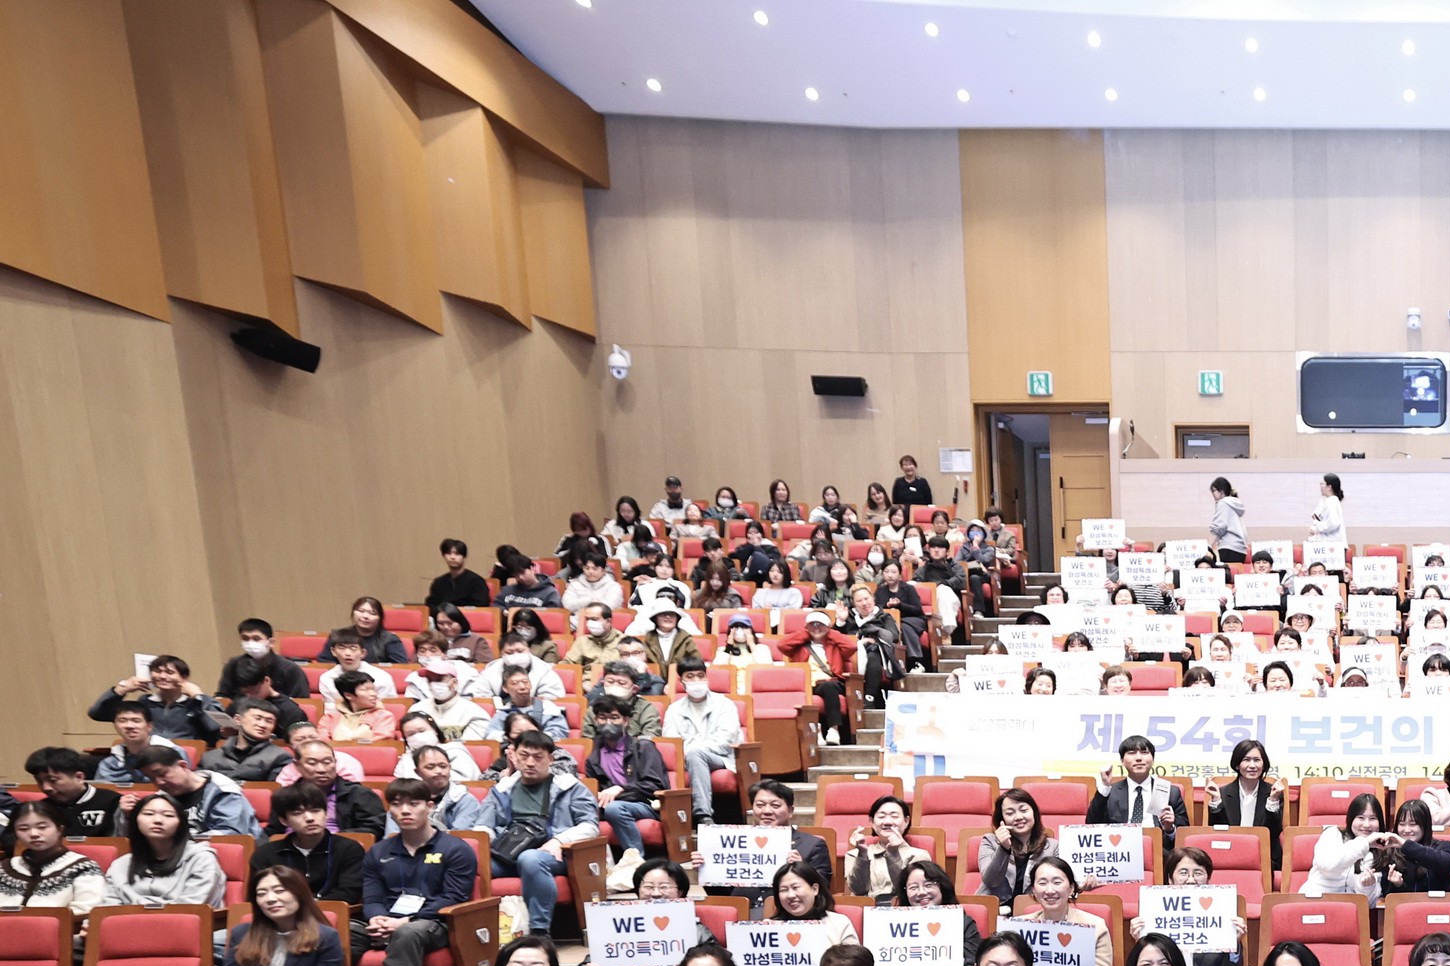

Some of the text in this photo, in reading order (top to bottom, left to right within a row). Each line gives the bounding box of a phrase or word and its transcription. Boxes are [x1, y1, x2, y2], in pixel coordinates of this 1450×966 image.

[1092, 523, 1105, 531] WE
[1176, 544, 1188, 552] WE
[1313, 547, 1326, 555] WE
[1071, 562, 1085, 570] WE
[1129, 557, 1143, 566] WE
[1363, 563, 1377, 571] WE
[1191, 576, 1205, 584] WE
[1425, 573, 1438, 581] WE
[1245, 581, 1259, 589] WE
[1360, 601, 1374, 609] WE
[1083, 617, 1099, 626] WE
[1145, 623, 1161, 632] WE
[1011, 631, 1027, 639] WE
[1353, 654, 1371, 663] WE
[974, 680, 993, 691] WE
[1425, 686, 1443, 695] WE
[1077, 713, 1124, 754] 제
[1288, 714, 1433, 755] 보건의
[1294, 765, 1344, 779] 14:10
[720, 834, 748, 849] WE
[1077, 833, 1103, 848] WE
[712, 852, 778, 866] 화성특례시
[1071, 851, 1131, 864] 화성특례시
[726, 867, 765, 880] 보건소
[1083, 865, 1120, 878] 보건소
[1163, 896, 1192, 912] WE
[612, 916, 646, 934] WE
[1154, 915, 1222, 930] 화성특례시
[889, 922, 920, 938] WE
[749, 931, 780, 948] WE
[1020, 929, 1051, 947] WE
[1168, 932, 1208, 945] 보건소
[743, 952, 812, 966] 화성특례시
